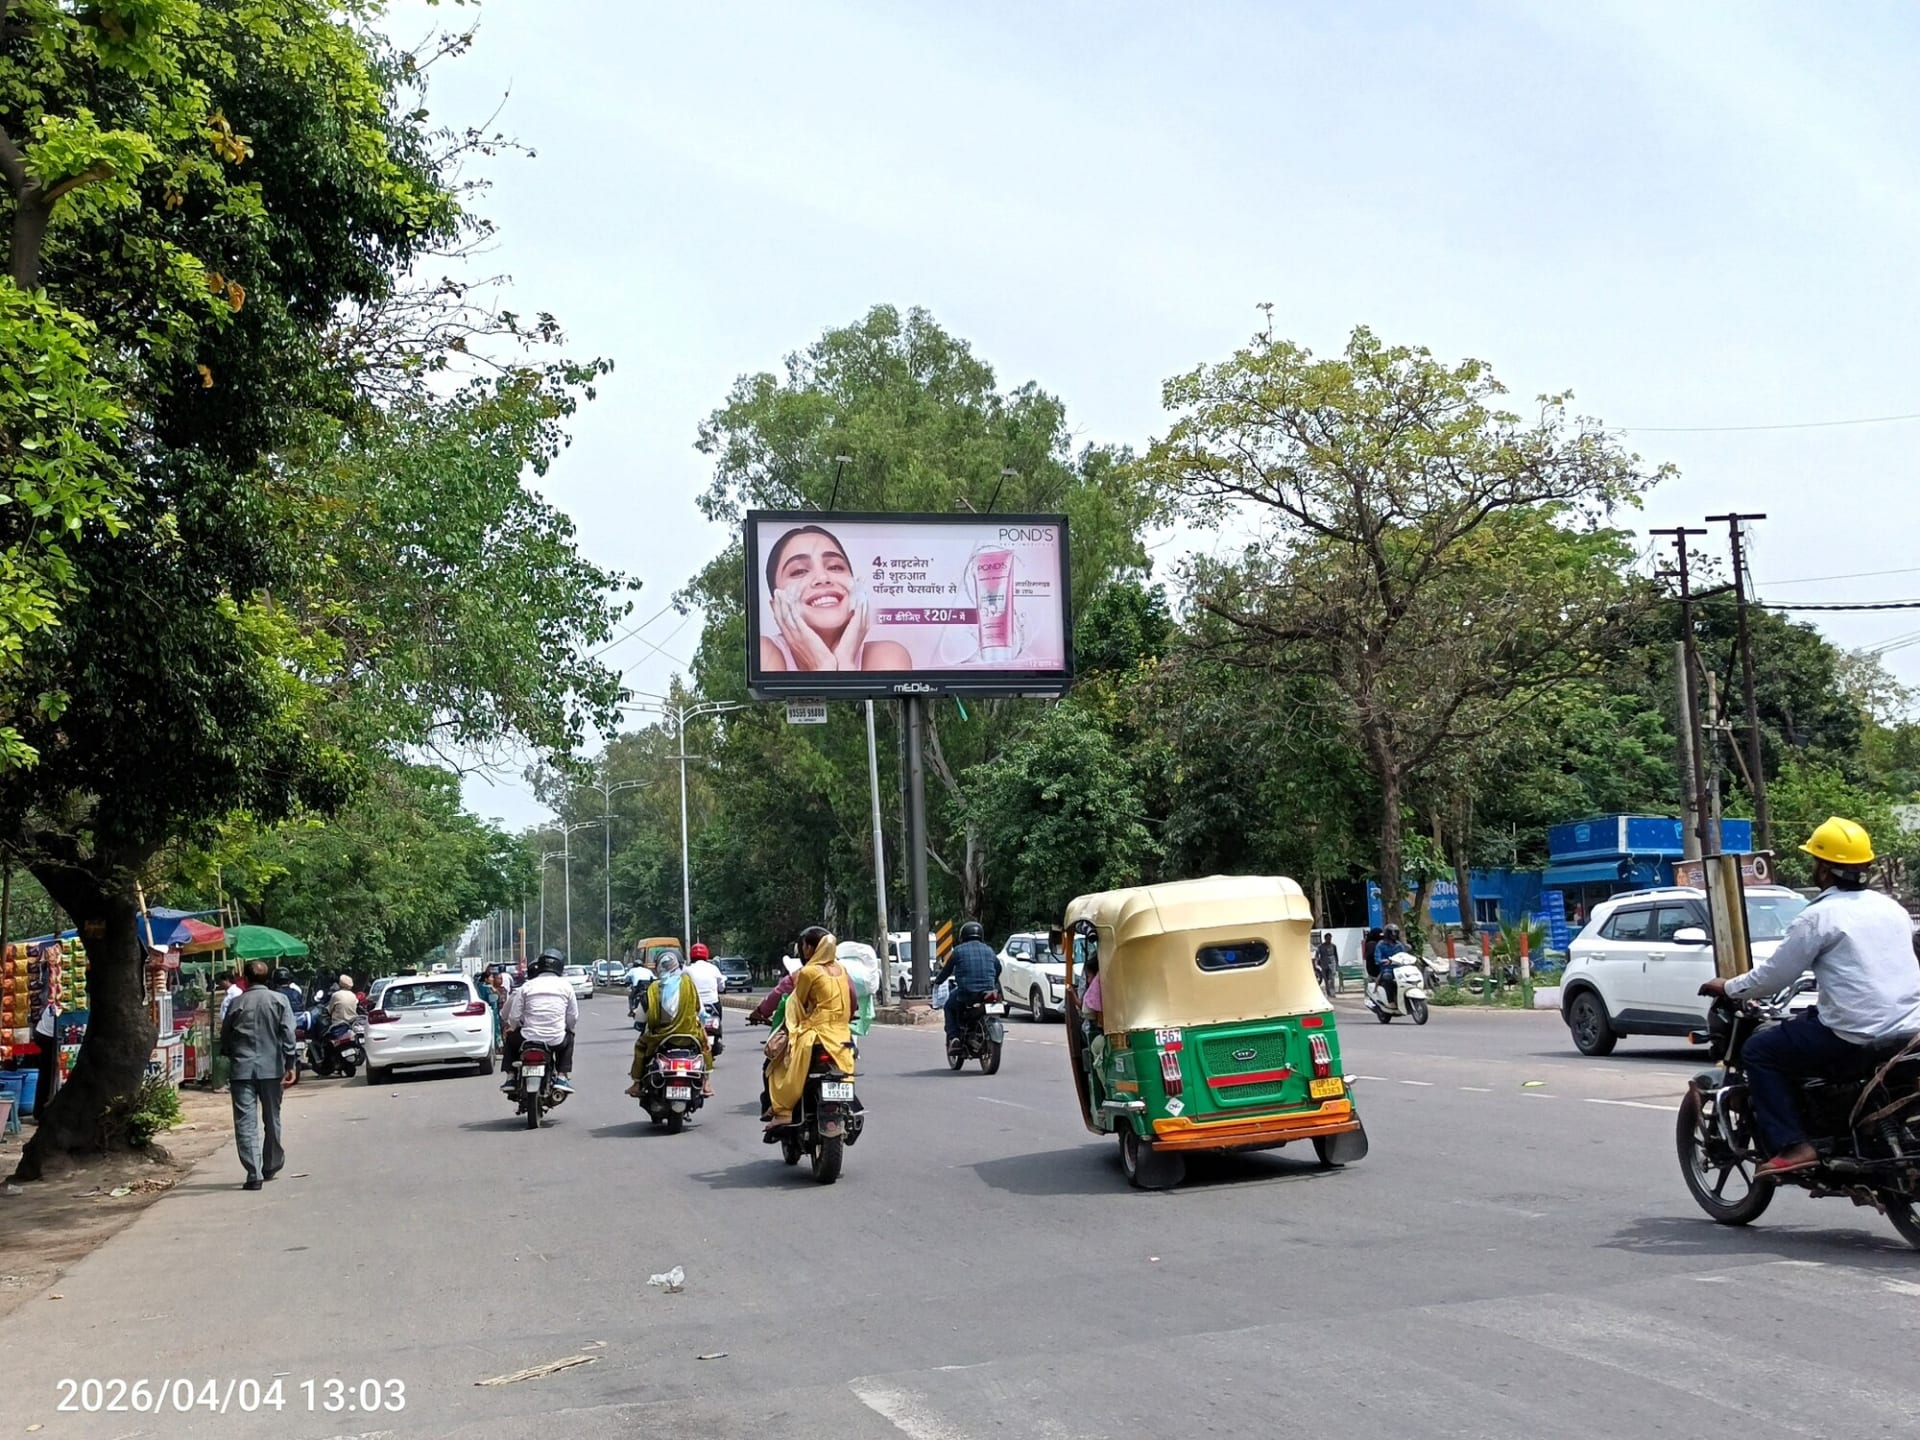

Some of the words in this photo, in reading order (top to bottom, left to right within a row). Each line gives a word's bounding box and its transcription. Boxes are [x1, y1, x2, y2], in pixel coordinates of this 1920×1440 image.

[999, 528, 1054, 542] POND'S
[977, 562, 1007, 572] POND'S
[872, 569, 885, 580] की
[888, 571, 926, 584] शुरुआत
[907, 582, 945, 594] फेसवॉश
[948, 582, 957, 594] से
[895, 611, 921, 622] कीजिए
[923, 610, 957, 622] ₹20/-
[1156, 1029, 1180, 1043] 1567
